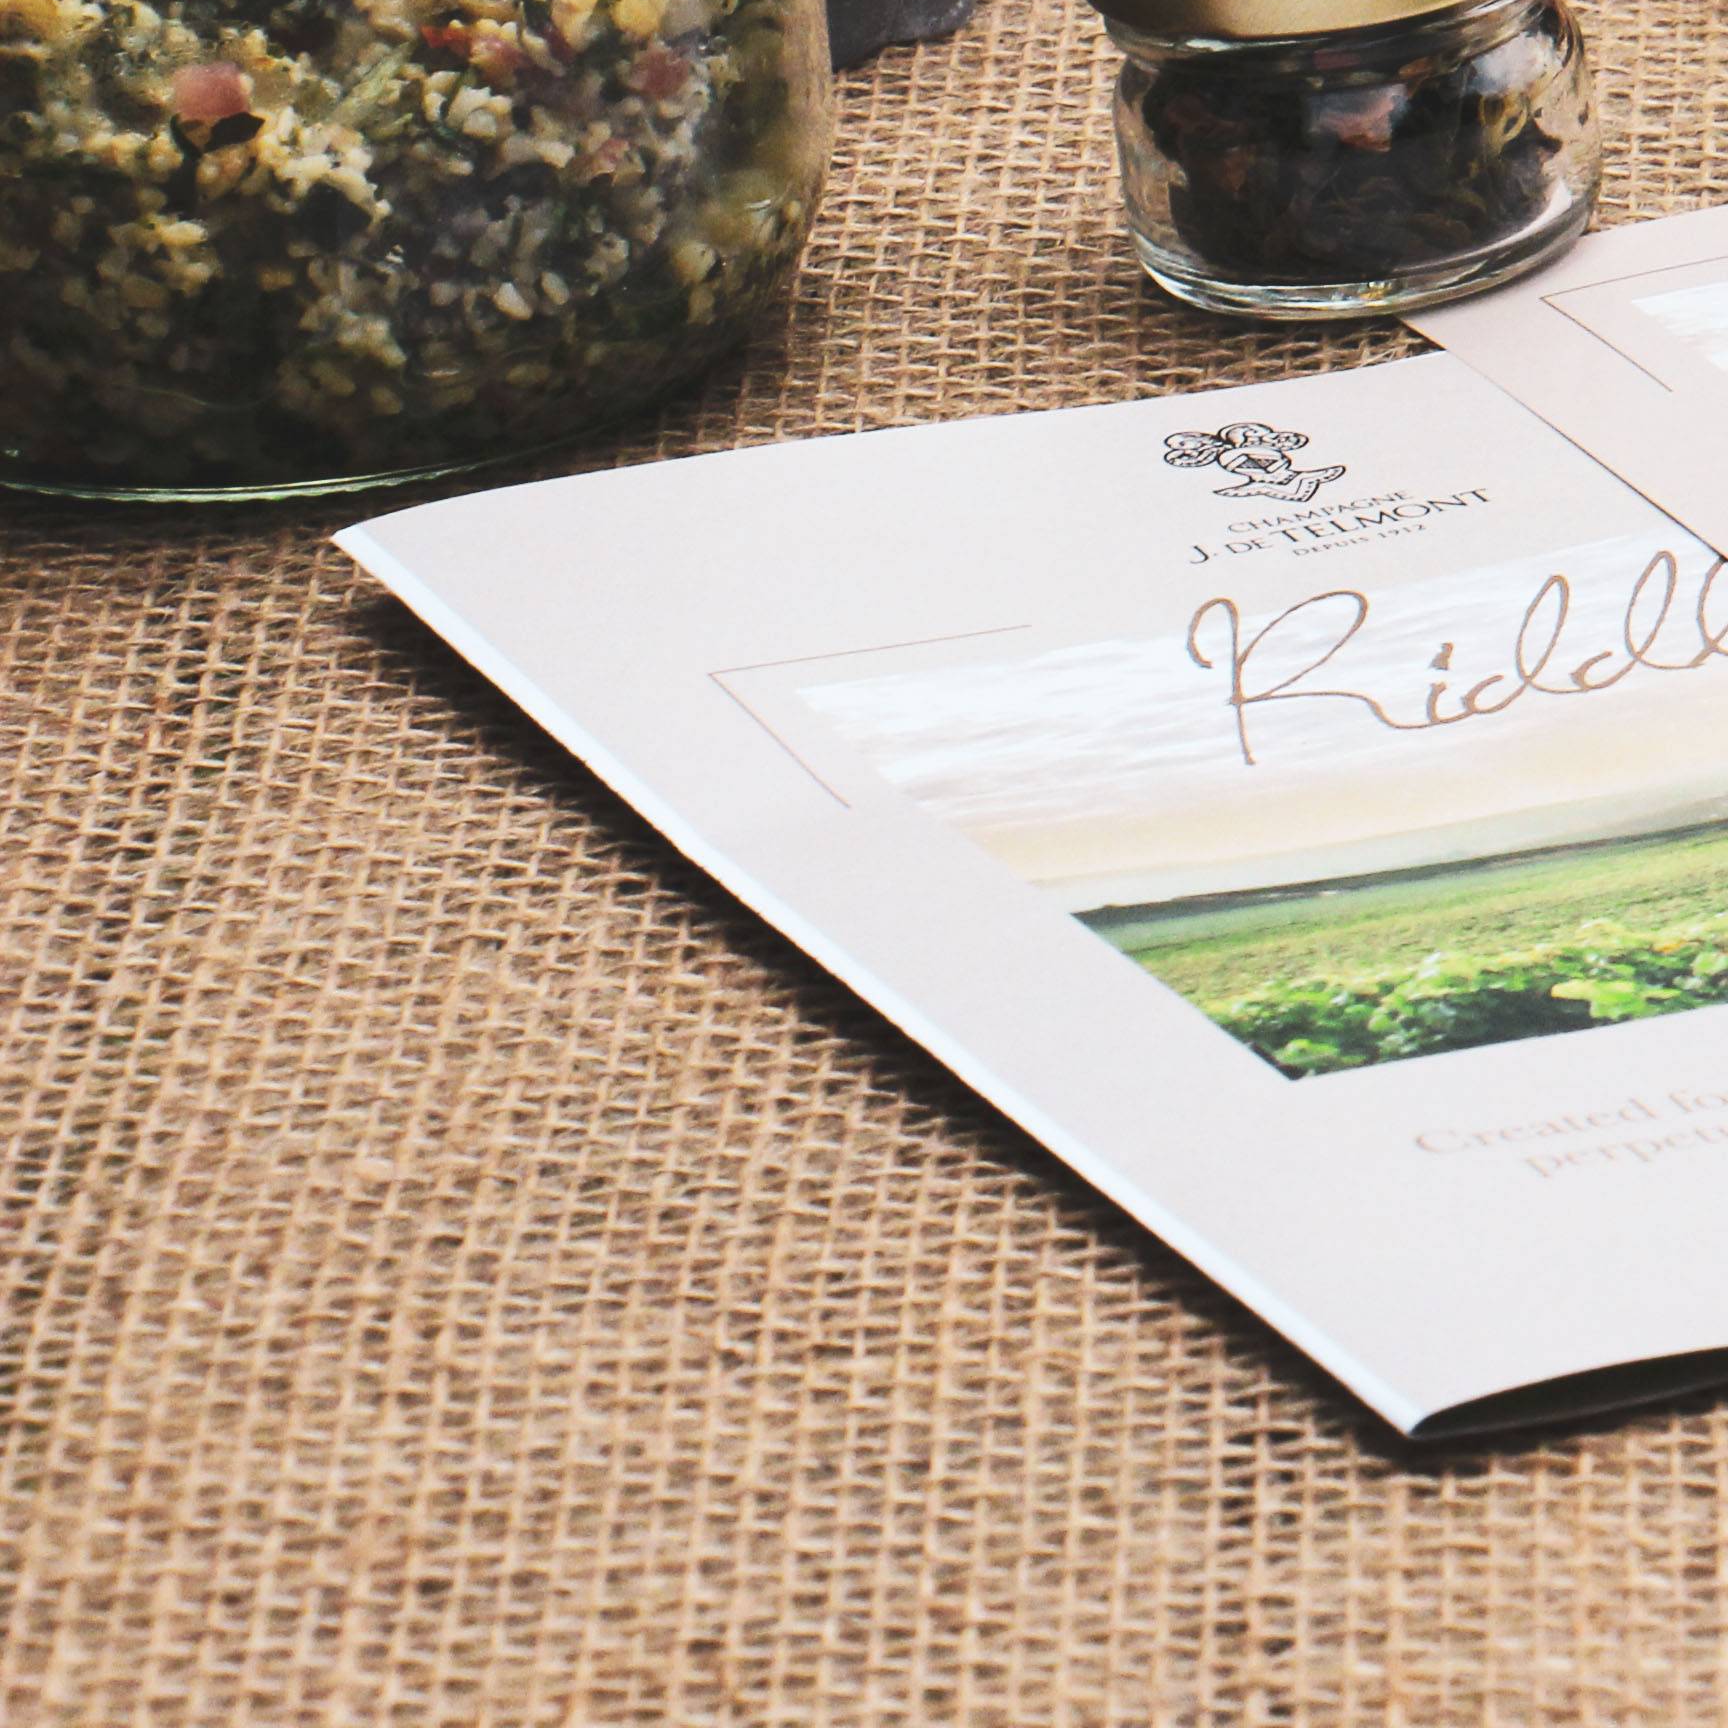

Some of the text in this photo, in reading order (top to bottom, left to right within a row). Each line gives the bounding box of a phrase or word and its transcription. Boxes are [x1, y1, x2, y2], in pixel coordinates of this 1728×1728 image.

[1227, 490, 1415, 534] CHAMPAGNE
[1228, 537, 1274, 555] DE
[1268, 487, 1491, 544] TELMONT
[1377, 523, 1427, 538] 1912
[1413, 1094, 1660, 1156] Created
